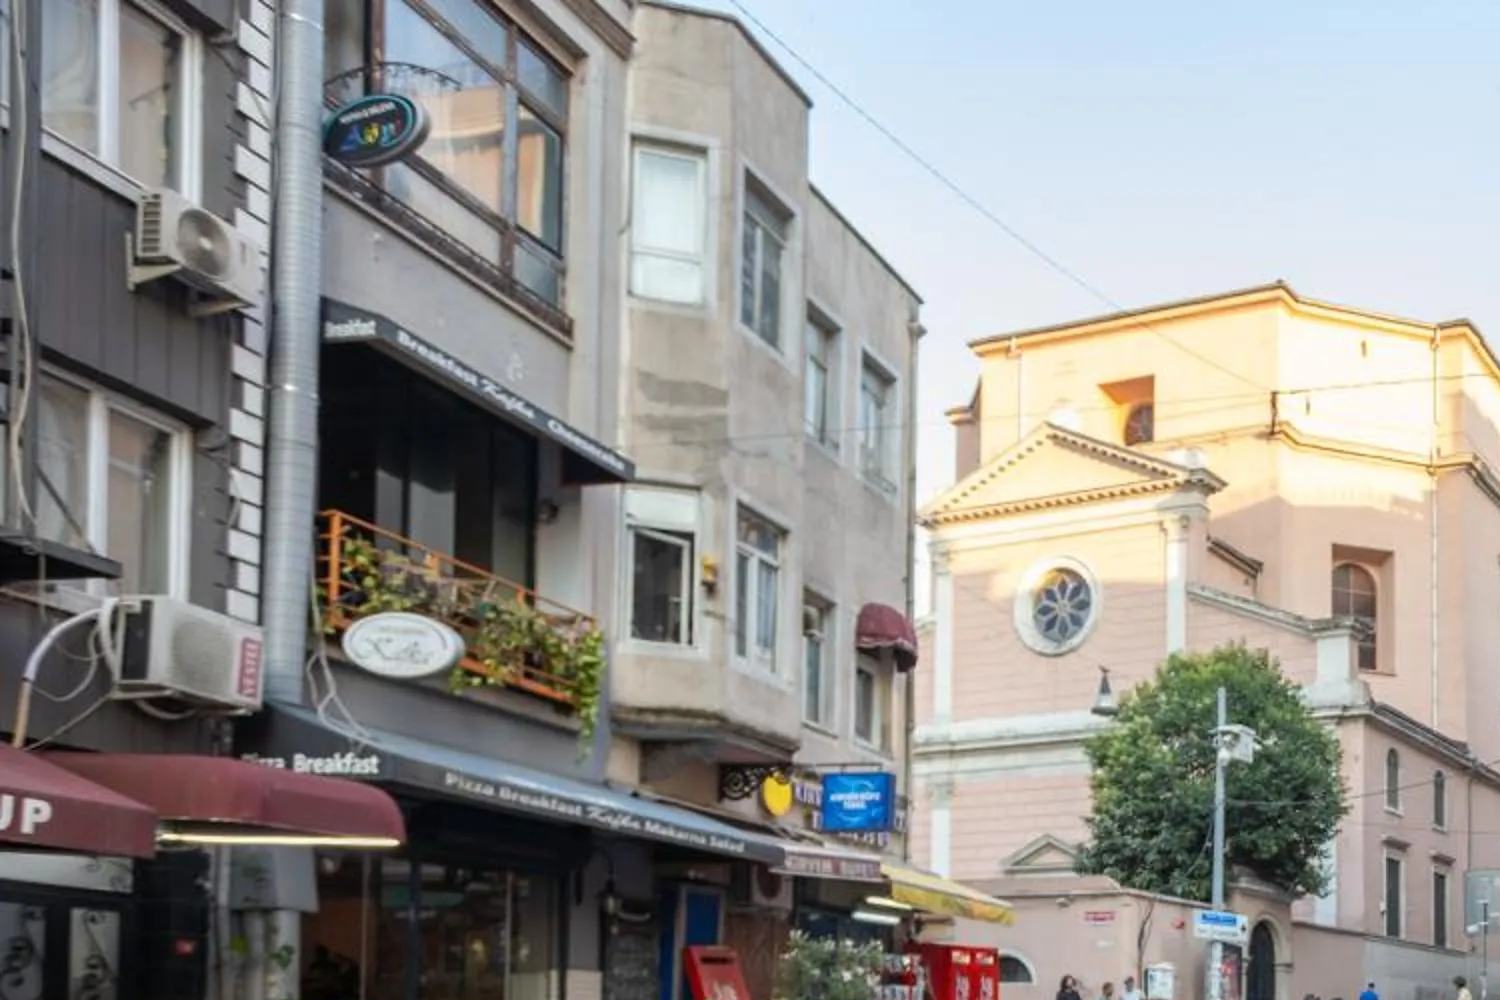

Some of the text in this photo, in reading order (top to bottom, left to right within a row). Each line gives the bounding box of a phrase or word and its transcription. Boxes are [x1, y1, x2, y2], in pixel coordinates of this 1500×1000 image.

[241, 752, 380, 774] zza Breakfast
[445, 771, 495, 797] Pizza
[499, 786, 582, 817] Breakfast
